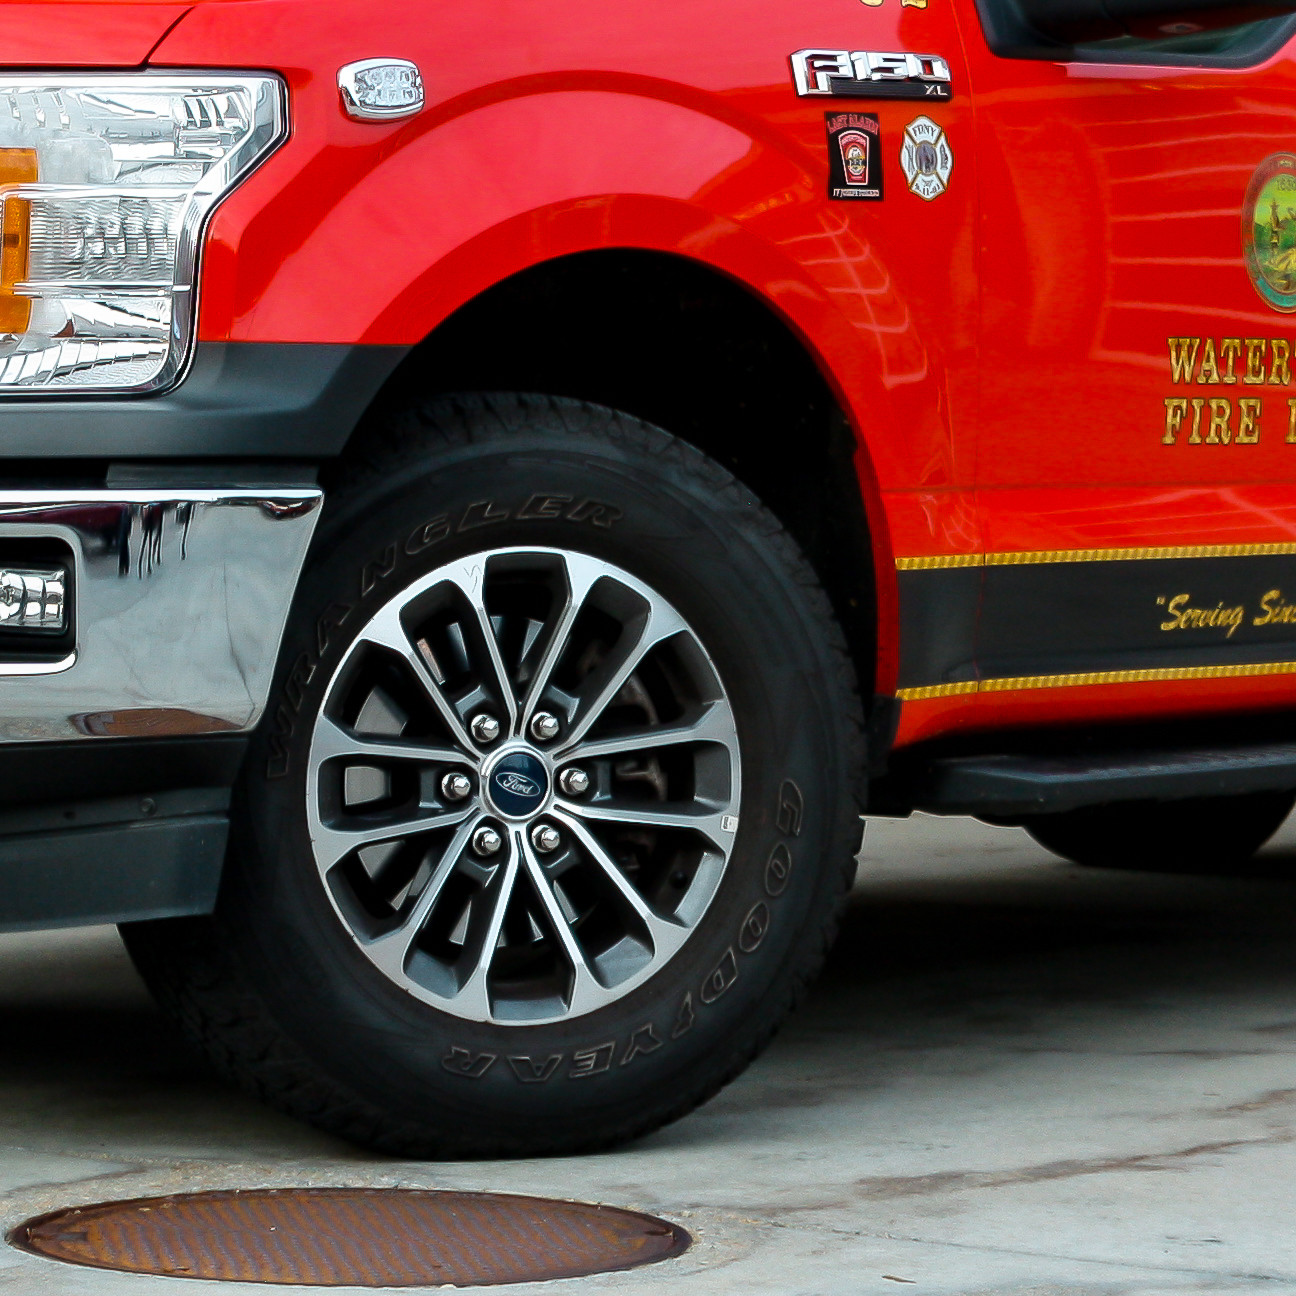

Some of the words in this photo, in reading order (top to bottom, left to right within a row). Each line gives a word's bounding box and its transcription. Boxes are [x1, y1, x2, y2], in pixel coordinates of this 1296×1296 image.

[924, 84, 948, 96] XL
[911, 121, 937, 138] FDNY
[1162, 398, 1261, 445] FIRE
[268, 493, 624, 779] WRANGLER
[503, 774, 534, 794] Ford
[441, 778, 805, 1083] GOODYEAR
